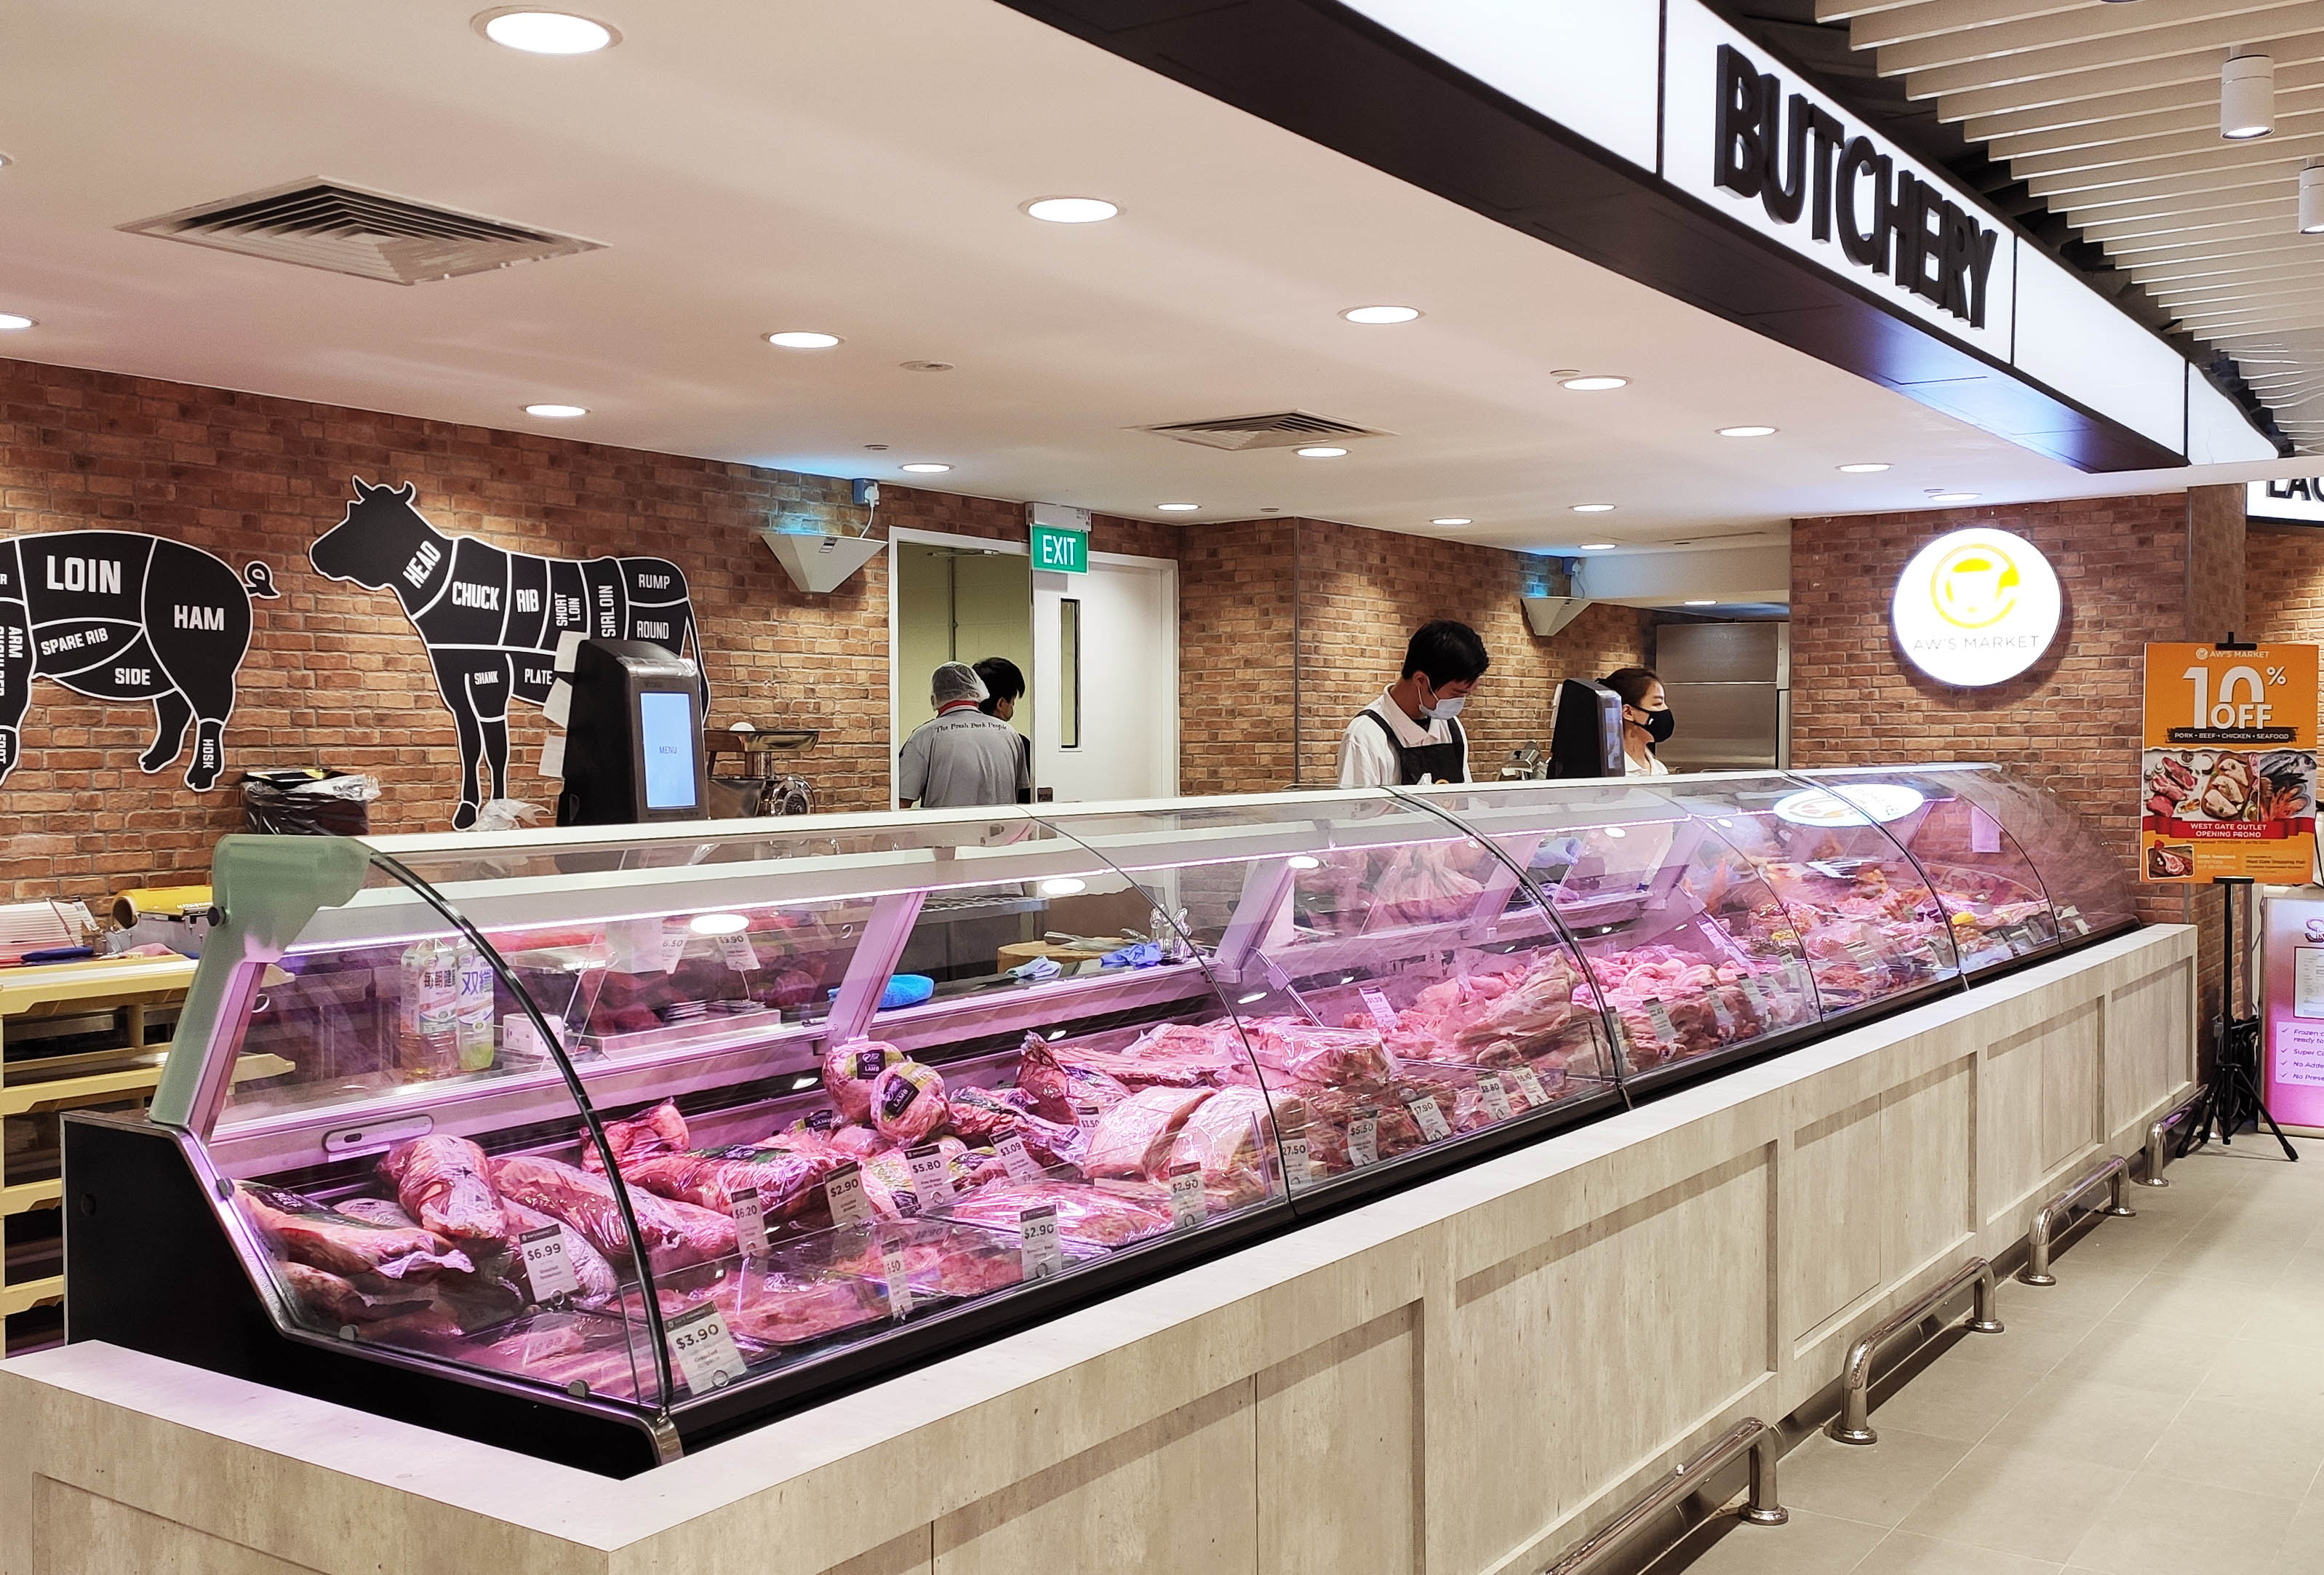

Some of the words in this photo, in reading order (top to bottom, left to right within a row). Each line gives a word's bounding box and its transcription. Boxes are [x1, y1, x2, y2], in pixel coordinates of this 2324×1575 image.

[1714, 44, 1999, 331] BUTCHERY
[1042, 535, 1077, 566] EXIT
[47, 555, 121, 594] LOIN
[402, 541, 442, 589] HEAD
[638, 574, 671, 591] RUMP
[452, 581, 500, 612] CHUCK
[516, 589, 540, 613] RIB
[174, 605, 225, 631] HAM
[554, 593, 569, 627] SHORT
[568, 597, 581, 622] LOIN
[599, 585, 616, 639] SIRLOIN
[636, 621, 669, 641] ROUND
[8, 626, 23, 658] ARM
[41, 634, 83, 656] SPARE
[87, 627, 108, 646] RIB
[1913, 637, 1957, 651] AW'S
[1964, 635, 2040, 649] MARKET
[2209, 650, 2232, 659] AW'S
[2234, 650, 2270, 659] MARKET
[115, 668, 151, 686] SIDE
[474, 671, 499, 686] SHANK
[524, 669, 553, 686] PLATE
[2211, 703, 2272, 730] OFF
[2174, 732, 2194, 740] PORK
[2256, 733, 2290, 741] SEAFOOD
[202, 739, 215, 769] HOSK
[659, 746, 678, 755] MENU
[893, 1088, 909, 1107] LAMB
[1351, 1123, 1374, 1136] $5.50
[1000, 1141, 1022, 1157] $3.09
[912, 1160, 941, 1174] $5.80
[830, 1179, 859, 1197] $2.90
[1173, 1179, 1199, 1194] $2.90
[735, 1205, 757, 1219] $6.20
[1024, 1224, 1055, 1240] $2.90
[527, 1243, 562, 1261] $6.99
[676, 1323, 719, 1351] $3.90
